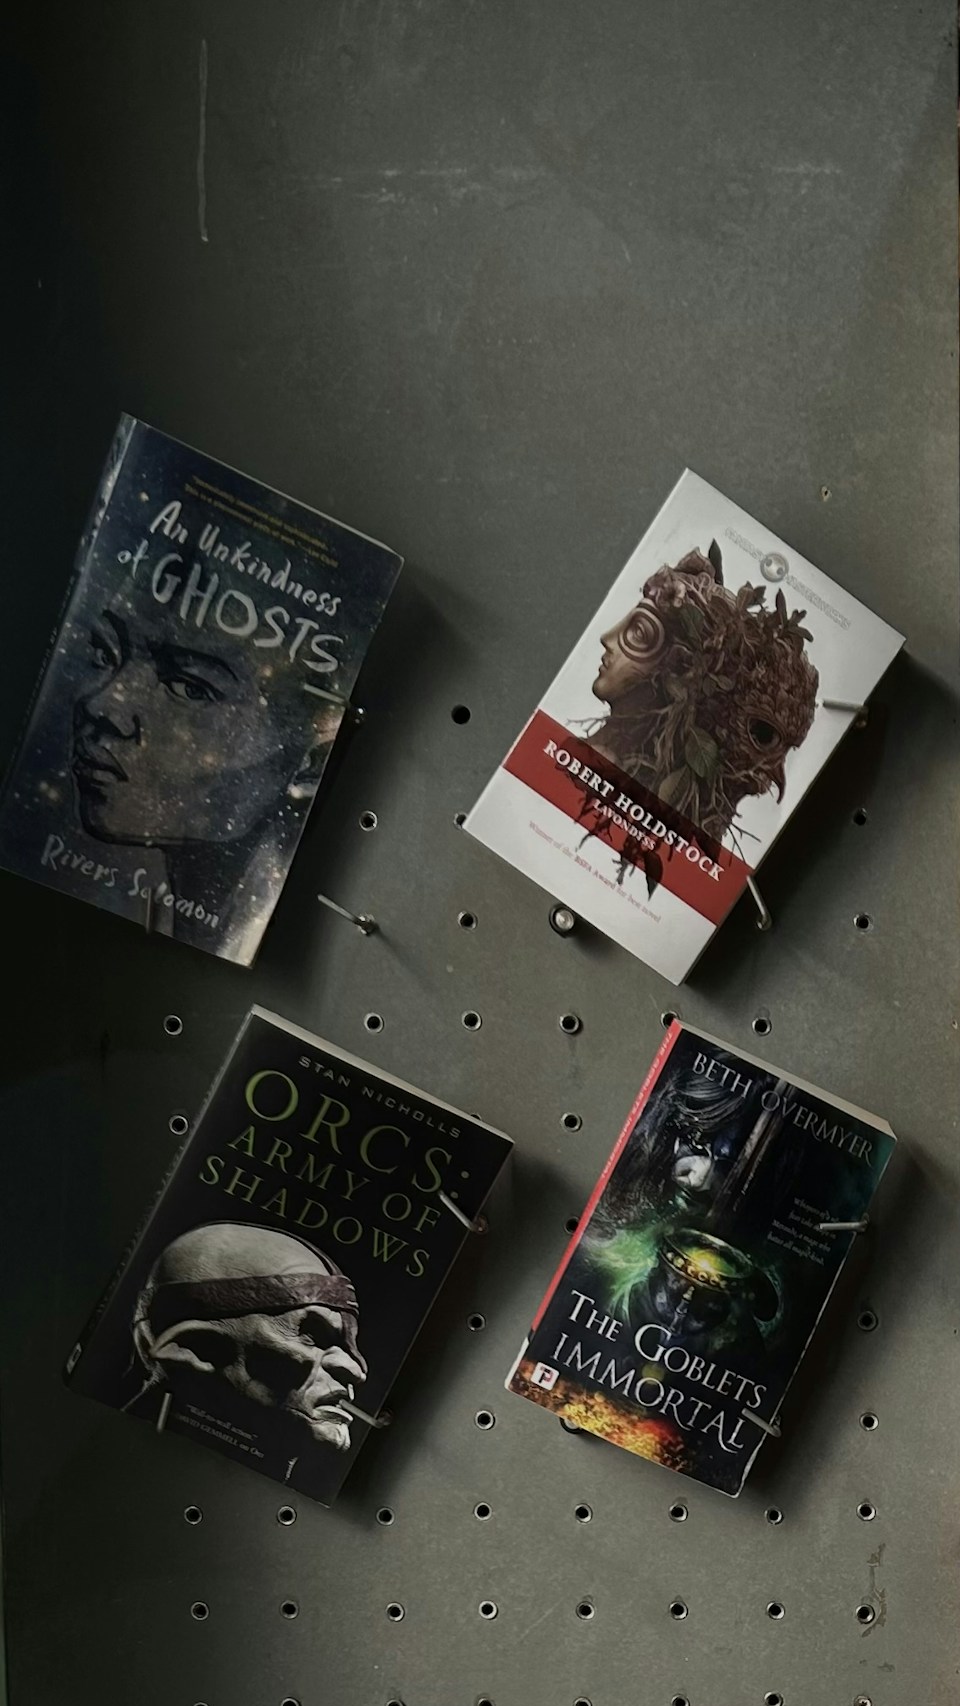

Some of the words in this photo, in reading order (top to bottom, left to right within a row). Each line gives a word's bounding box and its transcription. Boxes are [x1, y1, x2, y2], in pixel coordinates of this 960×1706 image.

[117, 540, 149, 578] of
[151, 552, 347, 674] GHOSTS
[150, 500, 188, 543] An
[199, 523, 342, 617] Unkindness
[41, 834, 119, 888] Rivers
[543, 739, 615, 796] ROBERT
[615, 792, 725, 882] HOLDSTOCK
[244, 1069, 470, 1200] ORCS:
[298, 1055, 351, 1088] STAN
[362, 1086, 462, 1139] NICHOLLS
[693, 1052, 753, 1099] BETH
[759, 1089, 876, 1166] OVERMYER
[200, 1155, 431, 1277] SHADOWS
[226, 1125, 372, 1200] ARMY
[381, 1193, 441, 1233] OF
[551, 1332, 746, 1453] IMMORTAL
[571, 1289, 624, 1343] THE
[633, 1322, 769, 1410] GOBLETS
